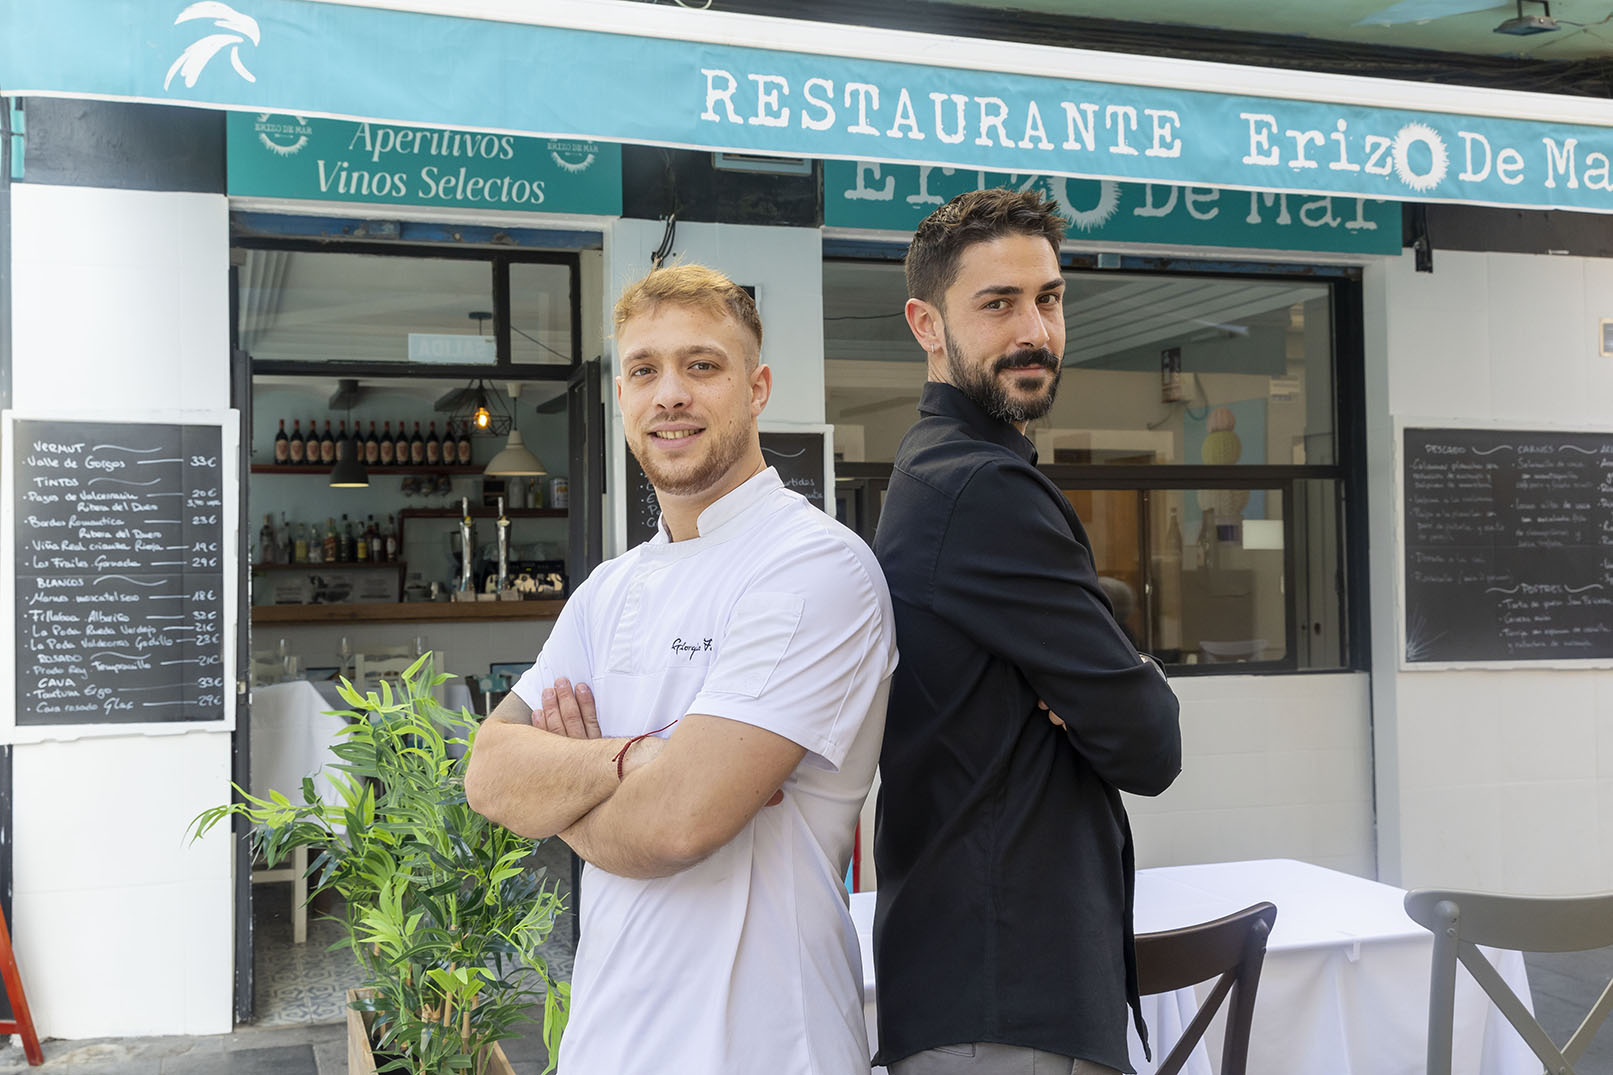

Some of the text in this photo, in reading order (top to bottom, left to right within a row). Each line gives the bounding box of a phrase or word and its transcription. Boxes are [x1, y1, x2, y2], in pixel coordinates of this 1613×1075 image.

[255, 123, 312, 134] ERIZO DE MAR
[701, 68, 1182, 158] RESTAURANTE
[1458, 130, 1525, 185] De
[348, 122, 514, 160] Aperitivos
[317, 160, 545, 204] Vinos Selectos
[27, 456, 60, 468] Valle
[64, 458, 78, 469] de
[190, 457, 217, 467] 33€
[65, 492, 78, 502] de
[191, 488, 217, 498] 20€
[112, 501, 129, 512] del
[115, 528, 130, 539] del
[192, 557, 217, 568] 29€
[37, 578, 85, 589] BLANCOS
[33, 625, 48, 637] La
[30, 639, 45, 650] La
[38, 678, 76, 688] CAVA
